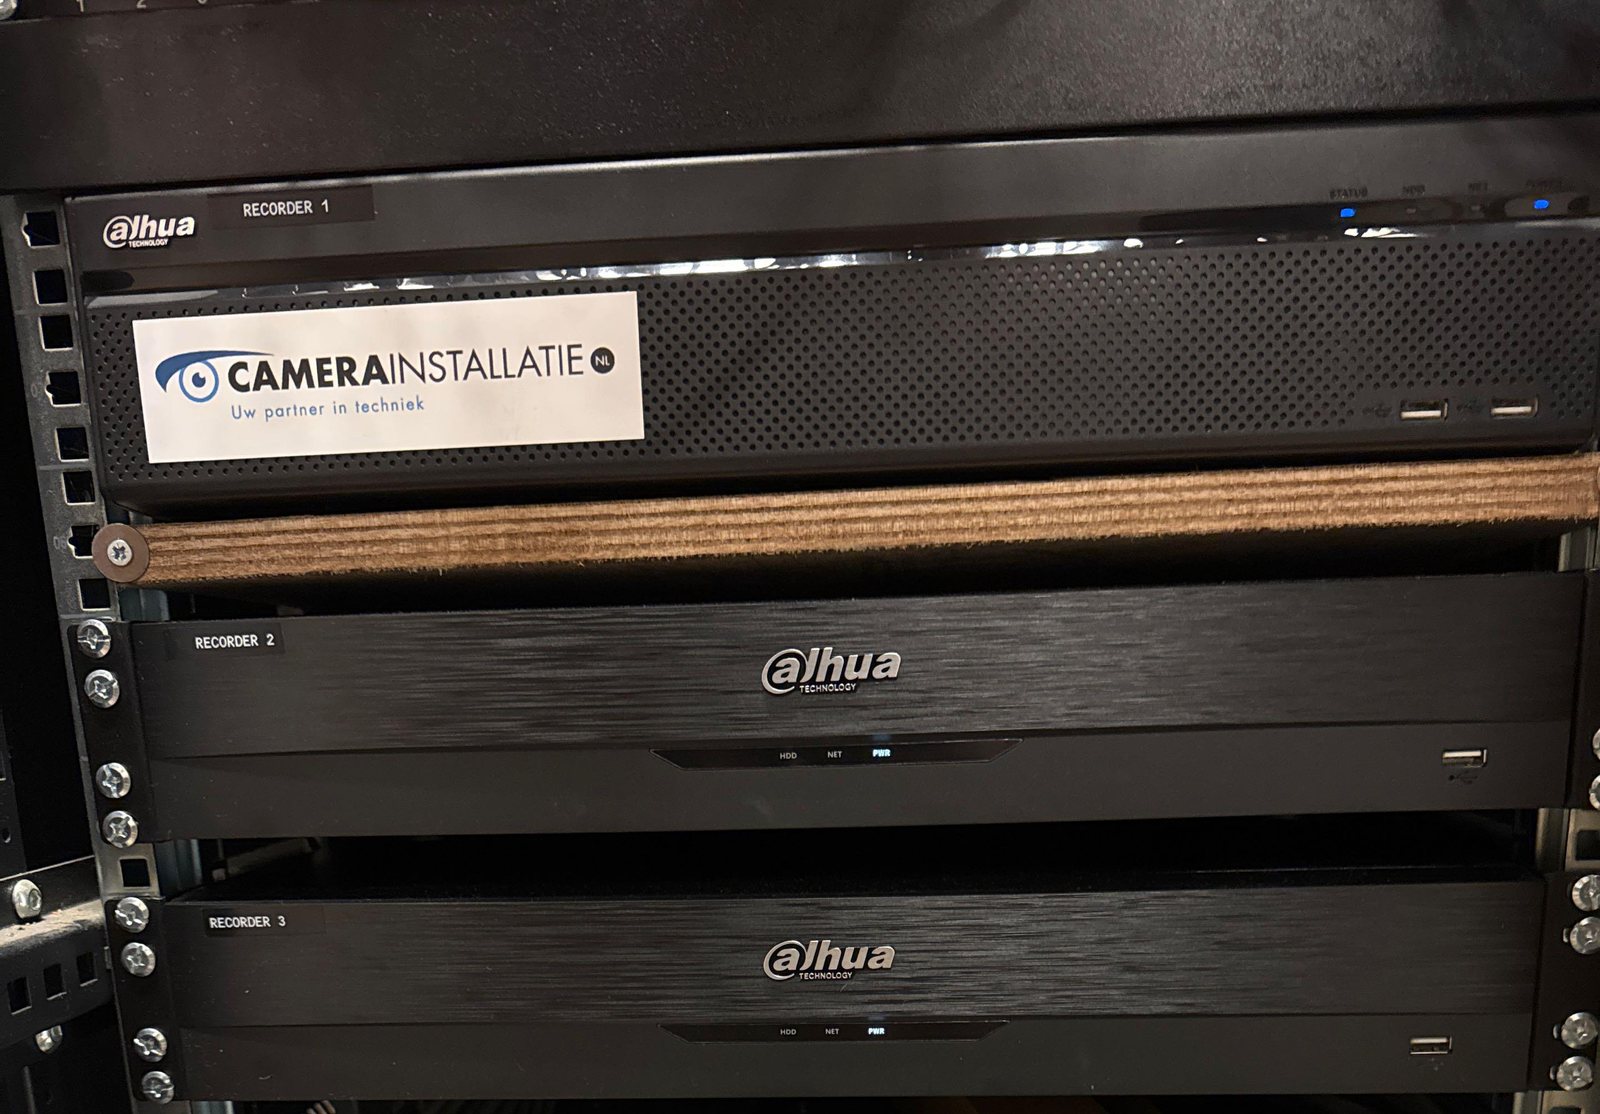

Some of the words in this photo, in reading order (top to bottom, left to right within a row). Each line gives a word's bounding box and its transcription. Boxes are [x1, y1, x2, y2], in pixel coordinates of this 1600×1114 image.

[242, 200, 314, 217] RECORDER
[321, 199, 330, 214] 1
[128, 238, 169, 249] TECHNOLOGY
[231, 404, 256, 420] Uw
[264, 401, 325, 422] partner
[333, 400, 348, 415] in
[355, 395, 425, 414] techniek
[194, 634, 258, 649] RECORDER
[266, 633, 275, 645] 2
[799, 682, 856, 693] TECHNOLOGY
[779, 752, 797, 760] HDD
[827, 750, 842, 759] NET
[872, 748, 890, 758] PWR
[208, 916, 272, 929] RECORDER
[277, 915, 286, 927] 3
[798, 971, 852, 980] TECHNOLOGY
[779, 1028, 797, 1036] HDD
[824, 1027, 840, 1036] NET
[867, 1026, 885, 1035] PWR
